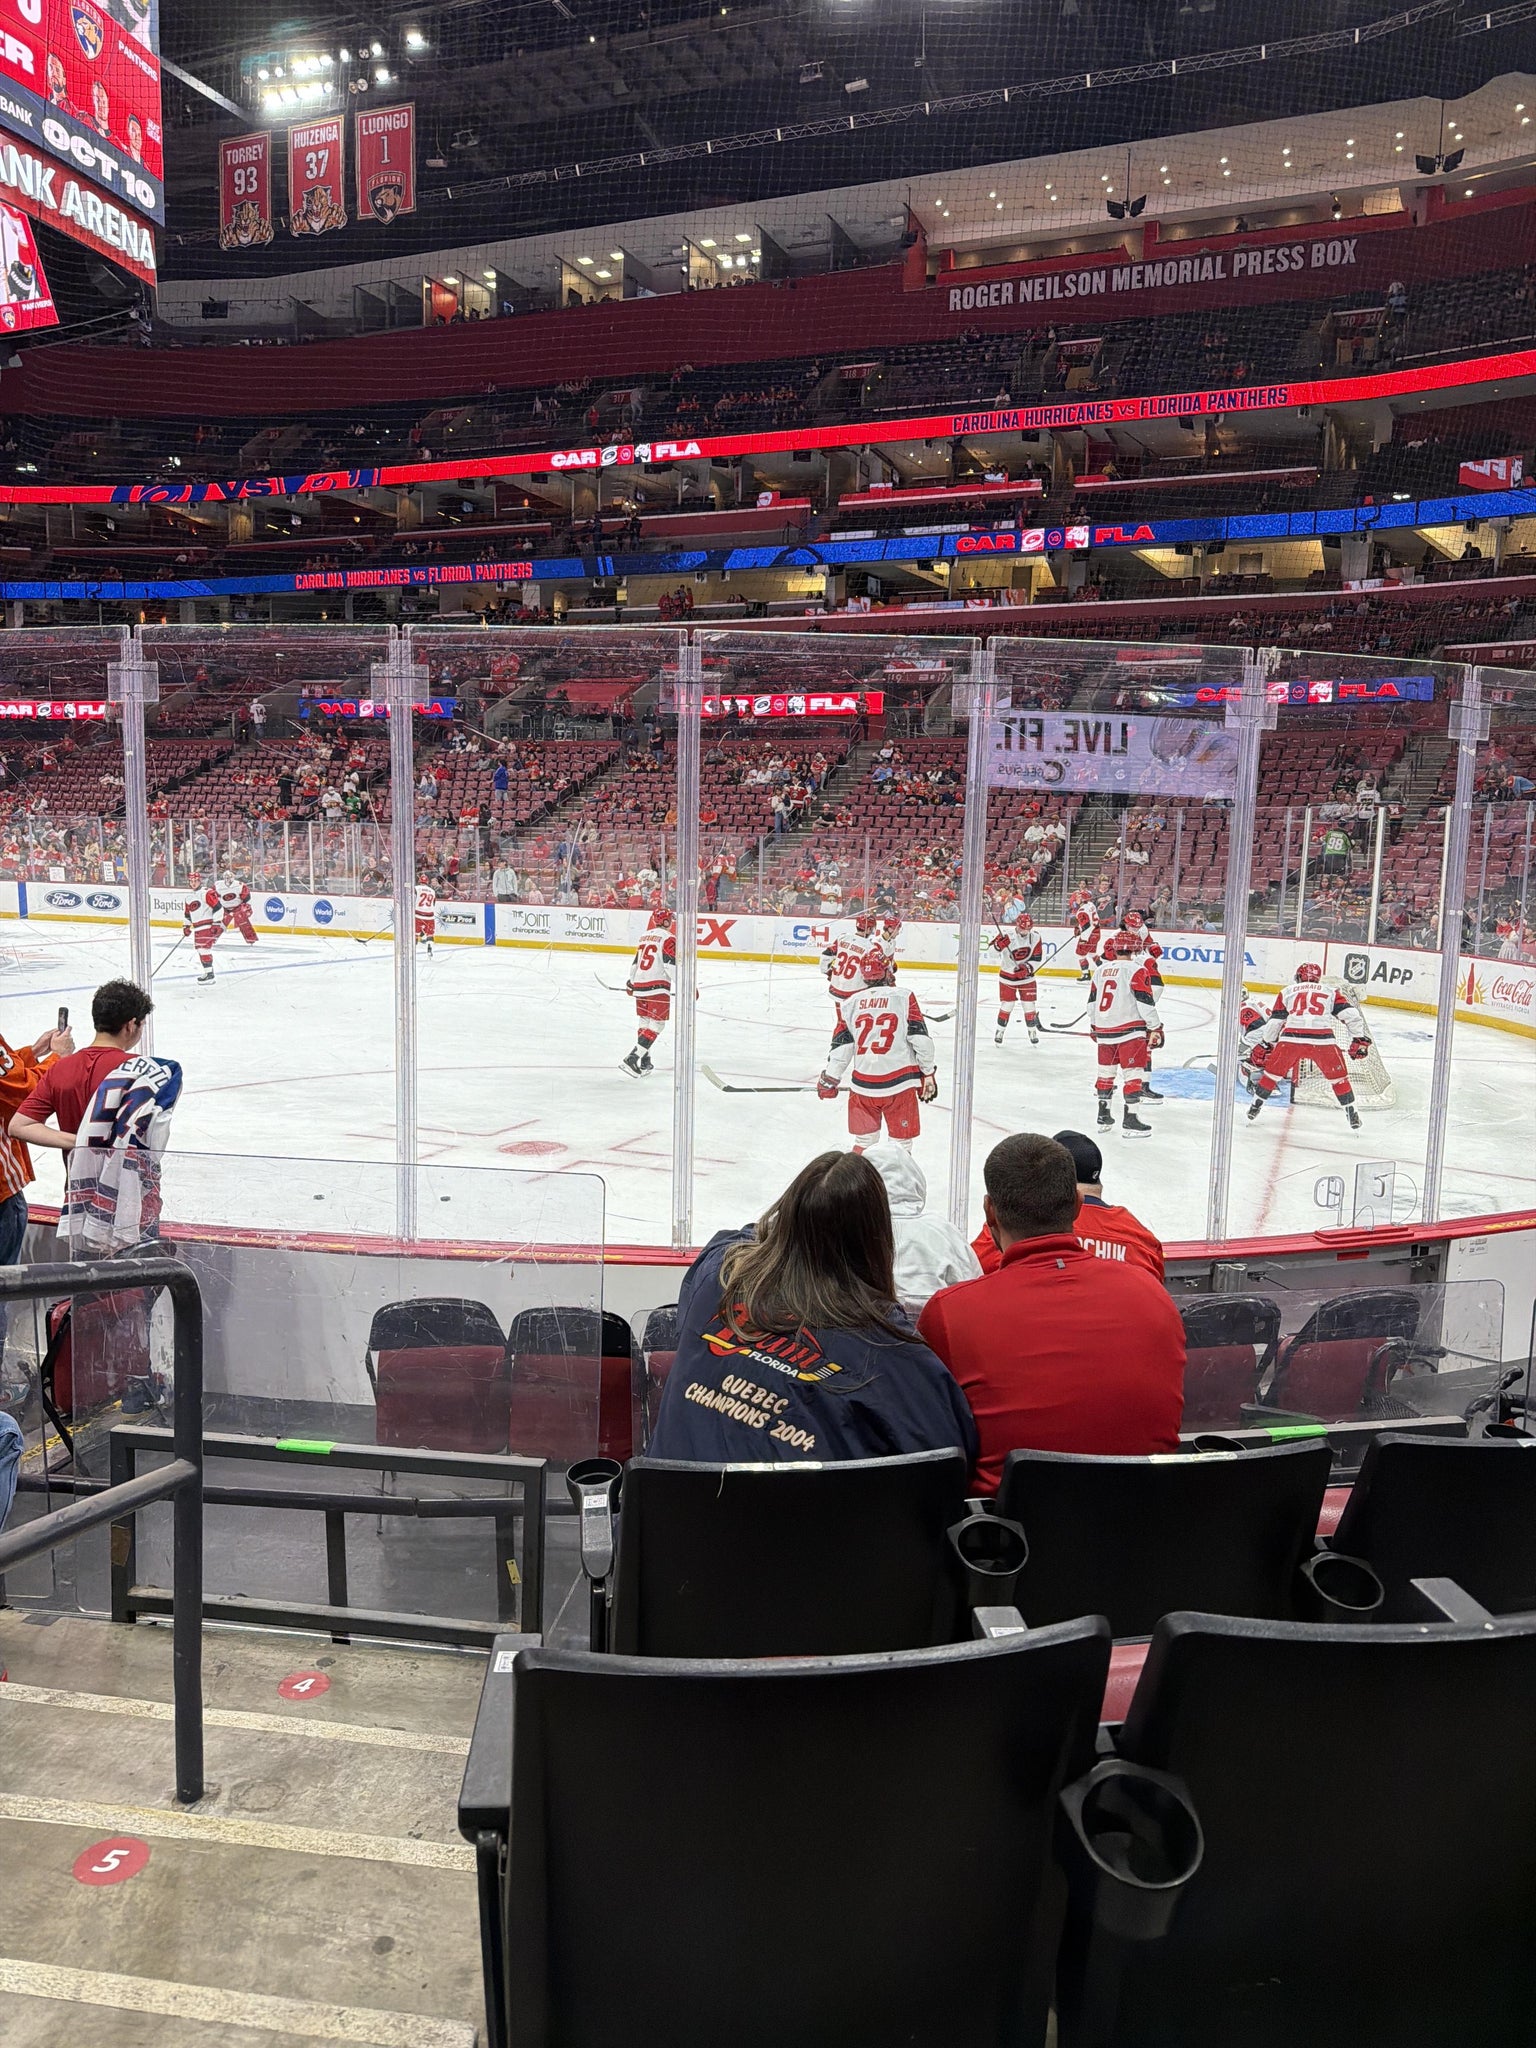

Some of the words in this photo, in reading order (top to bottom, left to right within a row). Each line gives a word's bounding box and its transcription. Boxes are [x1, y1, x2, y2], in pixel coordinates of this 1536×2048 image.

[0, 29, 35, 75] R
[118, 40, 158, 82] PANTHERS
[362, 111, 409, 136] LUONGO
[293, 125, 339, 149] HUIZENGA
[380, 135, 391, 164] 1
[42, 118, 119, 181] OCT
[121, 170, 156, 209] 10
[226, 143, 264, 166] TORREY
[305, 149, 329, 180] 37
[234, 166, 258, 195] 93
[59, 180, 156, 269] ARENA
[948, 282, 1014, 312] ROGER
[1019, 270, 1106, 306] NEILSON
[1111, 255, 1227, 292] MEMORIAL
[1232, 246, 1304, 278] PRESS
[1310, 239, 1358, 268] BOX
[953, 411, 1020, 433] CAROLINA
[1023, 403, 1113, 429] HURRICANES
[1139, 396, 1201, 422] FLORIDA
[1207, 387, 1288, 410] PANTHERS
[551, 451, 596, 467] CAR
[656, 442, 701, 458] FLA
[956, 534, 1015, 552] CAR
[1095, 525, 1156, 543] FLA
[295, 572, 344, 590] CAROLINA
[347, 568, 410, 588] HURRICANES
[428, 565, 473, 583] FLORIDA
[475, 562, 533, 581] PANTHERS
[1520, 646, 1536, 659] 12
[1338, 683, 1400, 698] FLA
[154, 898, 184, 914] Baptist
[265, 905, 285, 914] World
[313, 907, 333, 917] World
[418, 892, 434, 907] 29
[512, 910, 524, 919] THE
[565, 913, 577, 922] THE
[512, 926, 551, 936] chiropractic
[565, 930, 605, 939] chiropractic
[832, 951, 861, 980] 36
[859, 997, 889, 1009] SLAVIN
[1099, 979, 1118, 1012] 6
[854, 1012, 899, 1055] 23
[749, 1350, 799, 1378] FLORIDA
[721, 1374, 789, 1414] QUEBEC
[685, 1382, 771, 1429] CHAMPIONS
[770, 1420, 817, 1452] 2004
[292, 1678, 316, 1693] 4
[92, 1849, 130, 1873] 5
